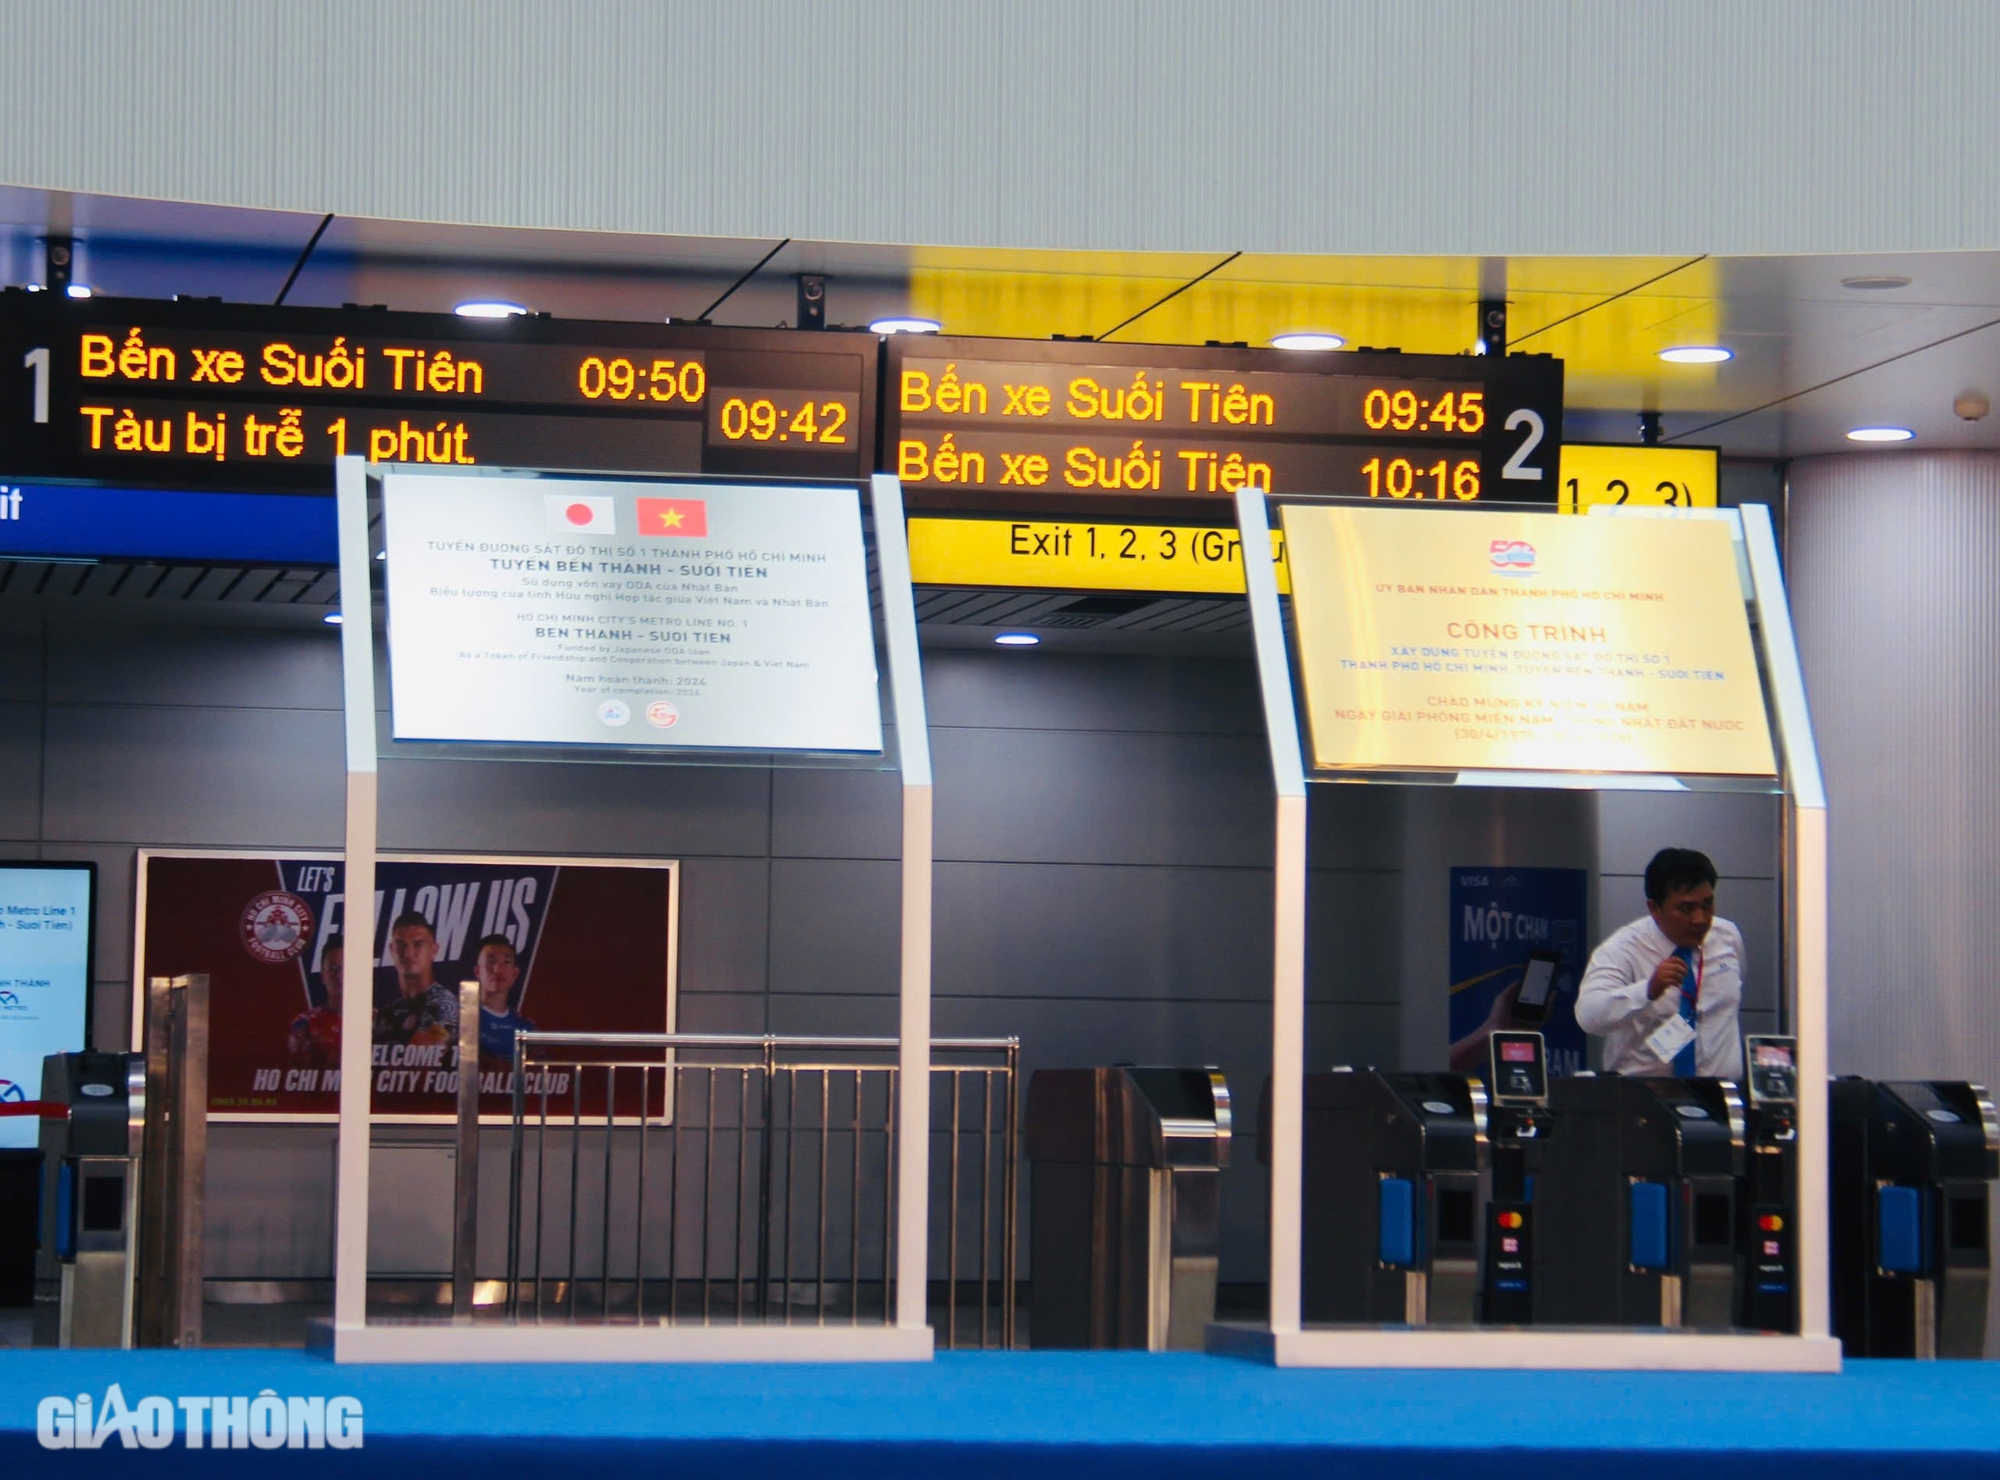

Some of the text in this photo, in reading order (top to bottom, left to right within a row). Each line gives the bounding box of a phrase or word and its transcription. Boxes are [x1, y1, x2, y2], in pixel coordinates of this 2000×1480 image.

[81, 327, 706, 403] Bến xe Suối Tiên 09:50
[24, 348, 49, 423] 1
[900, 361, 1485, 433] Bến xe Suối Tiên 09:45
[721, 398, 847, 444] 09:42
[80, 407, 475, 464] Tàu bị trễ 1 phút.
[1502, 408, 1545, 480] 2
[898, 432, 1480, 501] Bến xe Suối Tiên 10:16
[1010, 525, 1071, 556] Exit
[1086, 526, 1106, 558] 1,
[1119, 528, 1147, 560] 2,
[1160, 530, 1177, 557] 3
[789, 553, 826, 564] MINH
[1397, 584, 1425, 594] BAN
[1629, 592, 1664, 602] MINH
[537, 613, 559, 622] CHI
[562, 614, 595, 623] MINH
[640, 617, 682, 626] METRO
[686, 618, 714, 627] LINE
[1447, 619, 1518, 640] CÔNG
[536, 627, 569, 639] BEN
[575, 628, 632, 640] THANH
[650, 631, 688, 642] SUOI
[693, 632, 731, 644] TIEN
[557, 643, 596, 652] Funded
[599, 644, 610, 654] by
[531, 653, 586, 664] Friendship
[588, 655, 607, 663] and
[674, 658, 718, 667] between
[297, 866, 335, 892] LET'S
[1460, 875, 1490, 887] VISA
[7, 905, 40, 916] Metro
[43, 905, 67, 916] Line
[70, 906, 76, 915] 1
[310, 876, 538, 973] FLLOW US
[1463, 901, 1513, 951] MỘT
[253, 1069, 280, 1091] HO
[284, 1070, 319, 1092] CHI
[376, 1070, 419, 1093] CITY
[522, 1072, 570, 1095] CLUB
